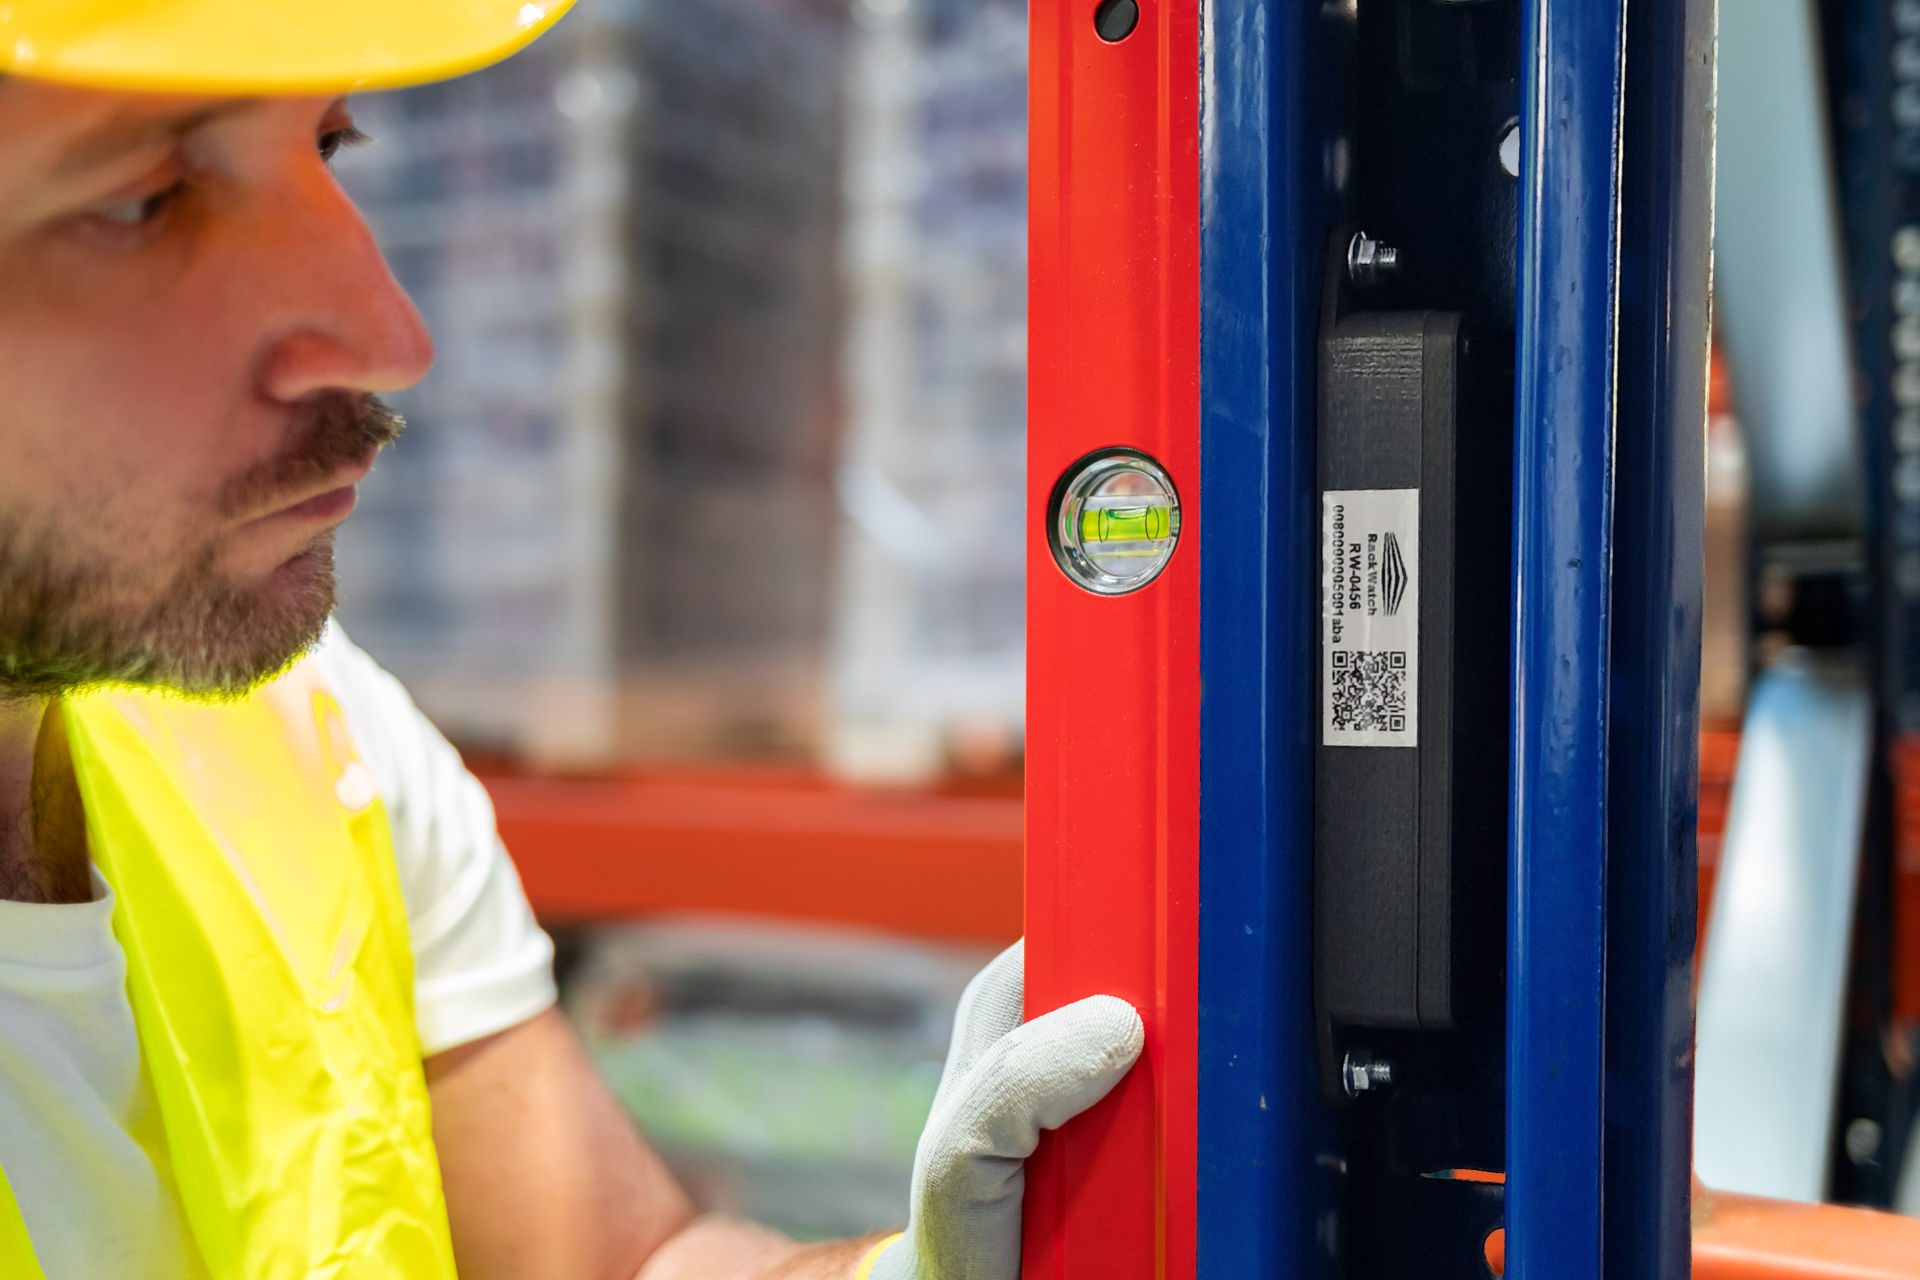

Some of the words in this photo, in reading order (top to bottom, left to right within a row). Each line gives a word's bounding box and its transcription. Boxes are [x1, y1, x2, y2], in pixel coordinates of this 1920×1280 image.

[1331, 504, 1345, 644] 0080000005001aba
[1349, 543, 1362, 610] RW-0456
[1367, 533, 1378, 616] RackWatch
